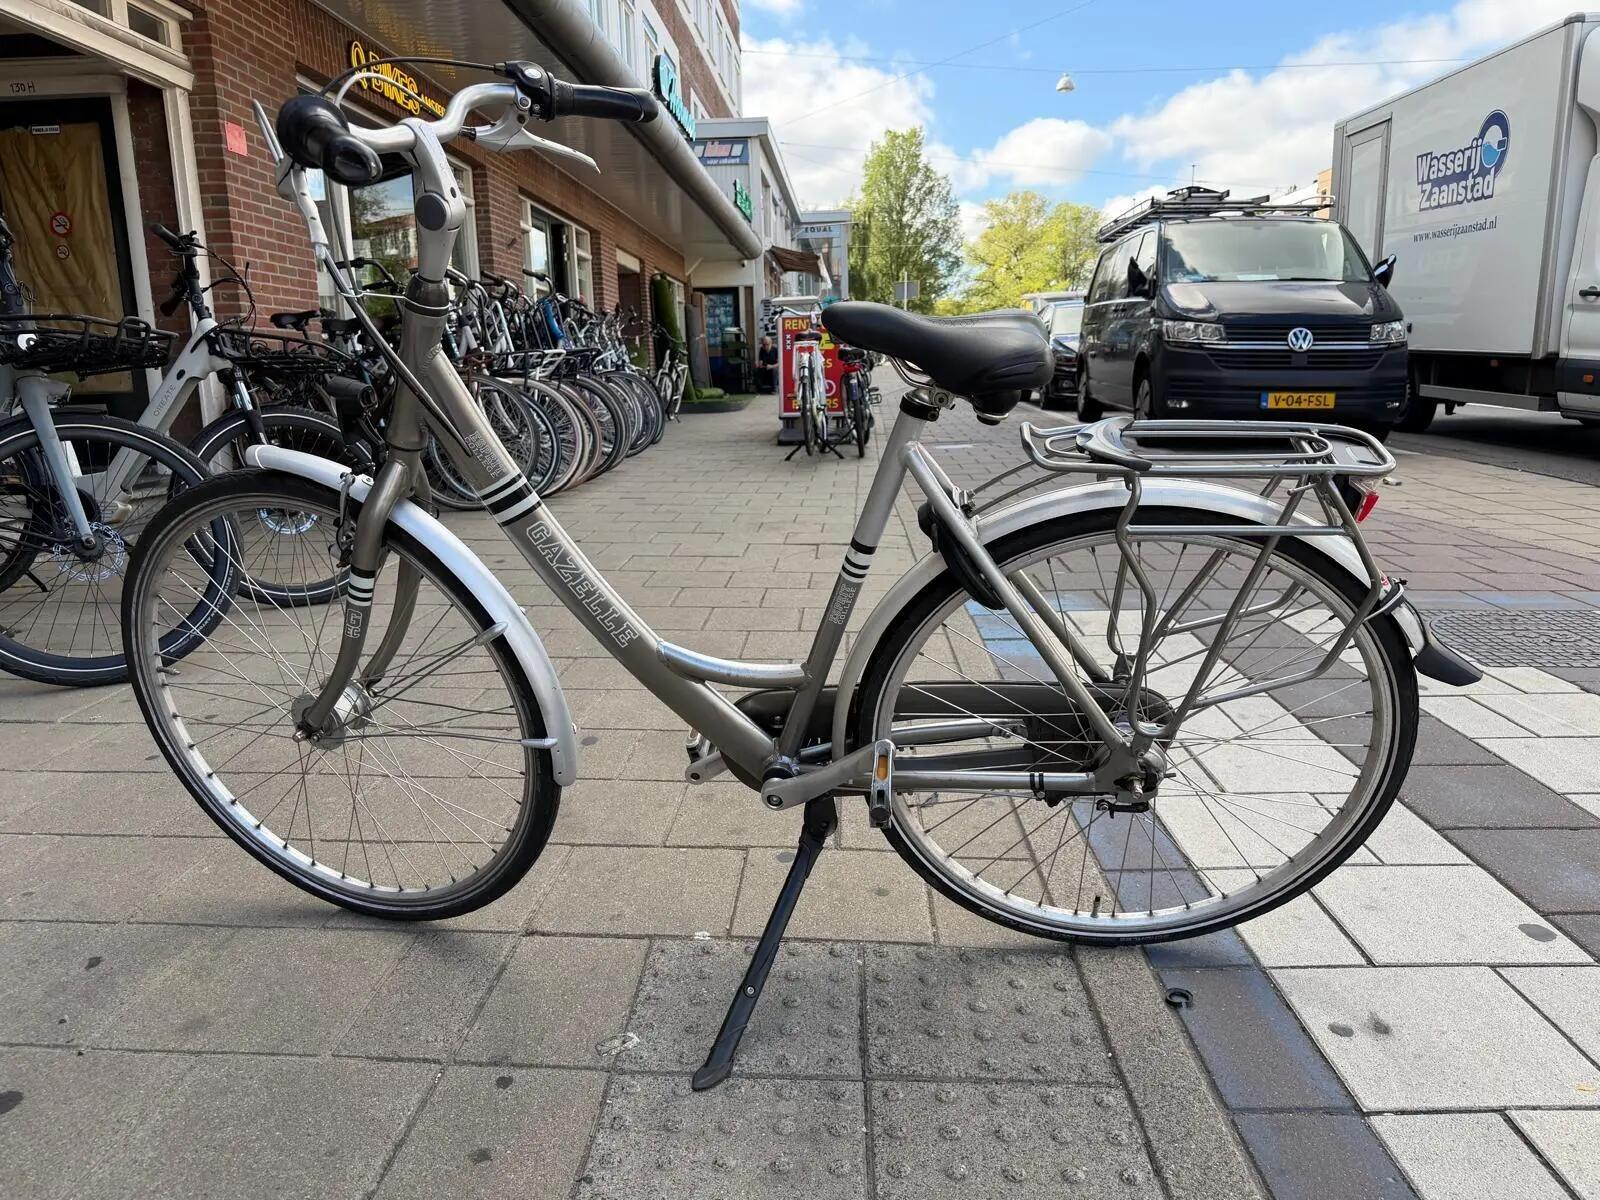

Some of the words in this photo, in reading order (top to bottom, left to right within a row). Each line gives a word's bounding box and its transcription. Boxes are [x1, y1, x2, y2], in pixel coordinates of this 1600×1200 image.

[10, 82, 26, 94] 130
[1417, 138, 1483, 184] Wasserij
[1418, 166, 1496, 210] Zaanstad
[804, 226, 833, 234] EQUAL
[1413, 216, 1498, 243] www.wasserijzaanstad.nl
[1273, 394, 1330, 407] V-04-FSL
[464, 437, 498, 479] COLLEGE
[526, 521, 639, 648] GAZELLE
